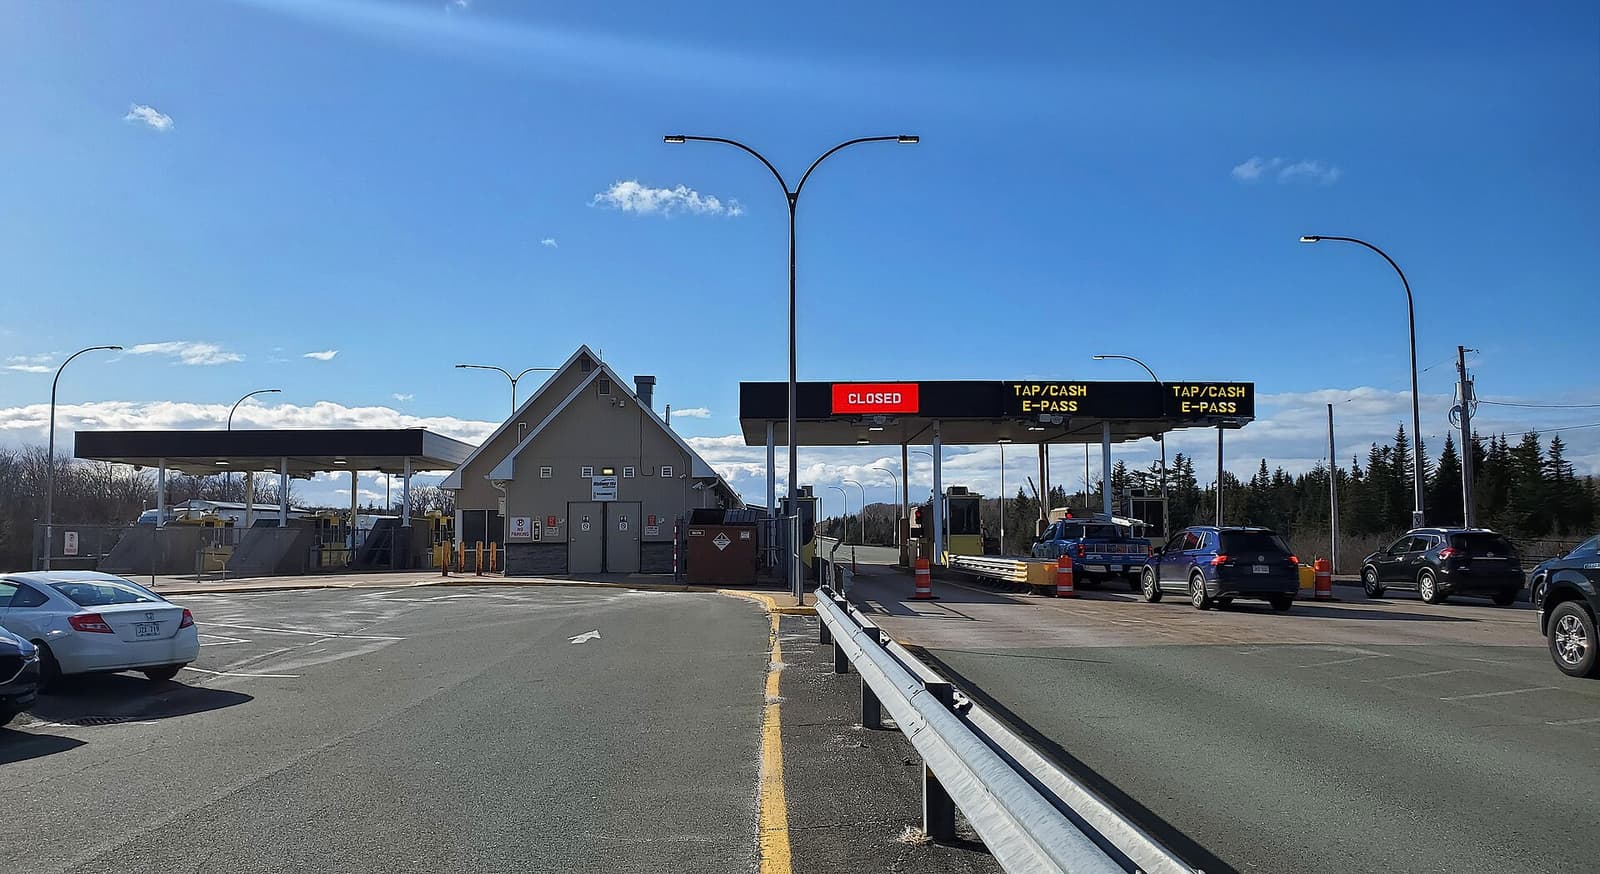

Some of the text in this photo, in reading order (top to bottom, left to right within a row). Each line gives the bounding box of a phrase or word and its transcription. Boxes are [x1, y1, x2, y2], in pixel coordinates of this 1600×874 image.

[1013, 384, 1087, 397] TAP/CASH
[1172, 386, 1246, 398] TAP/CASH
[848, 393, 902, 404] CLOSED
[1022, 400, 1078, 412] E-PASS
[1181, 401, 1237, 413] E-PASS
